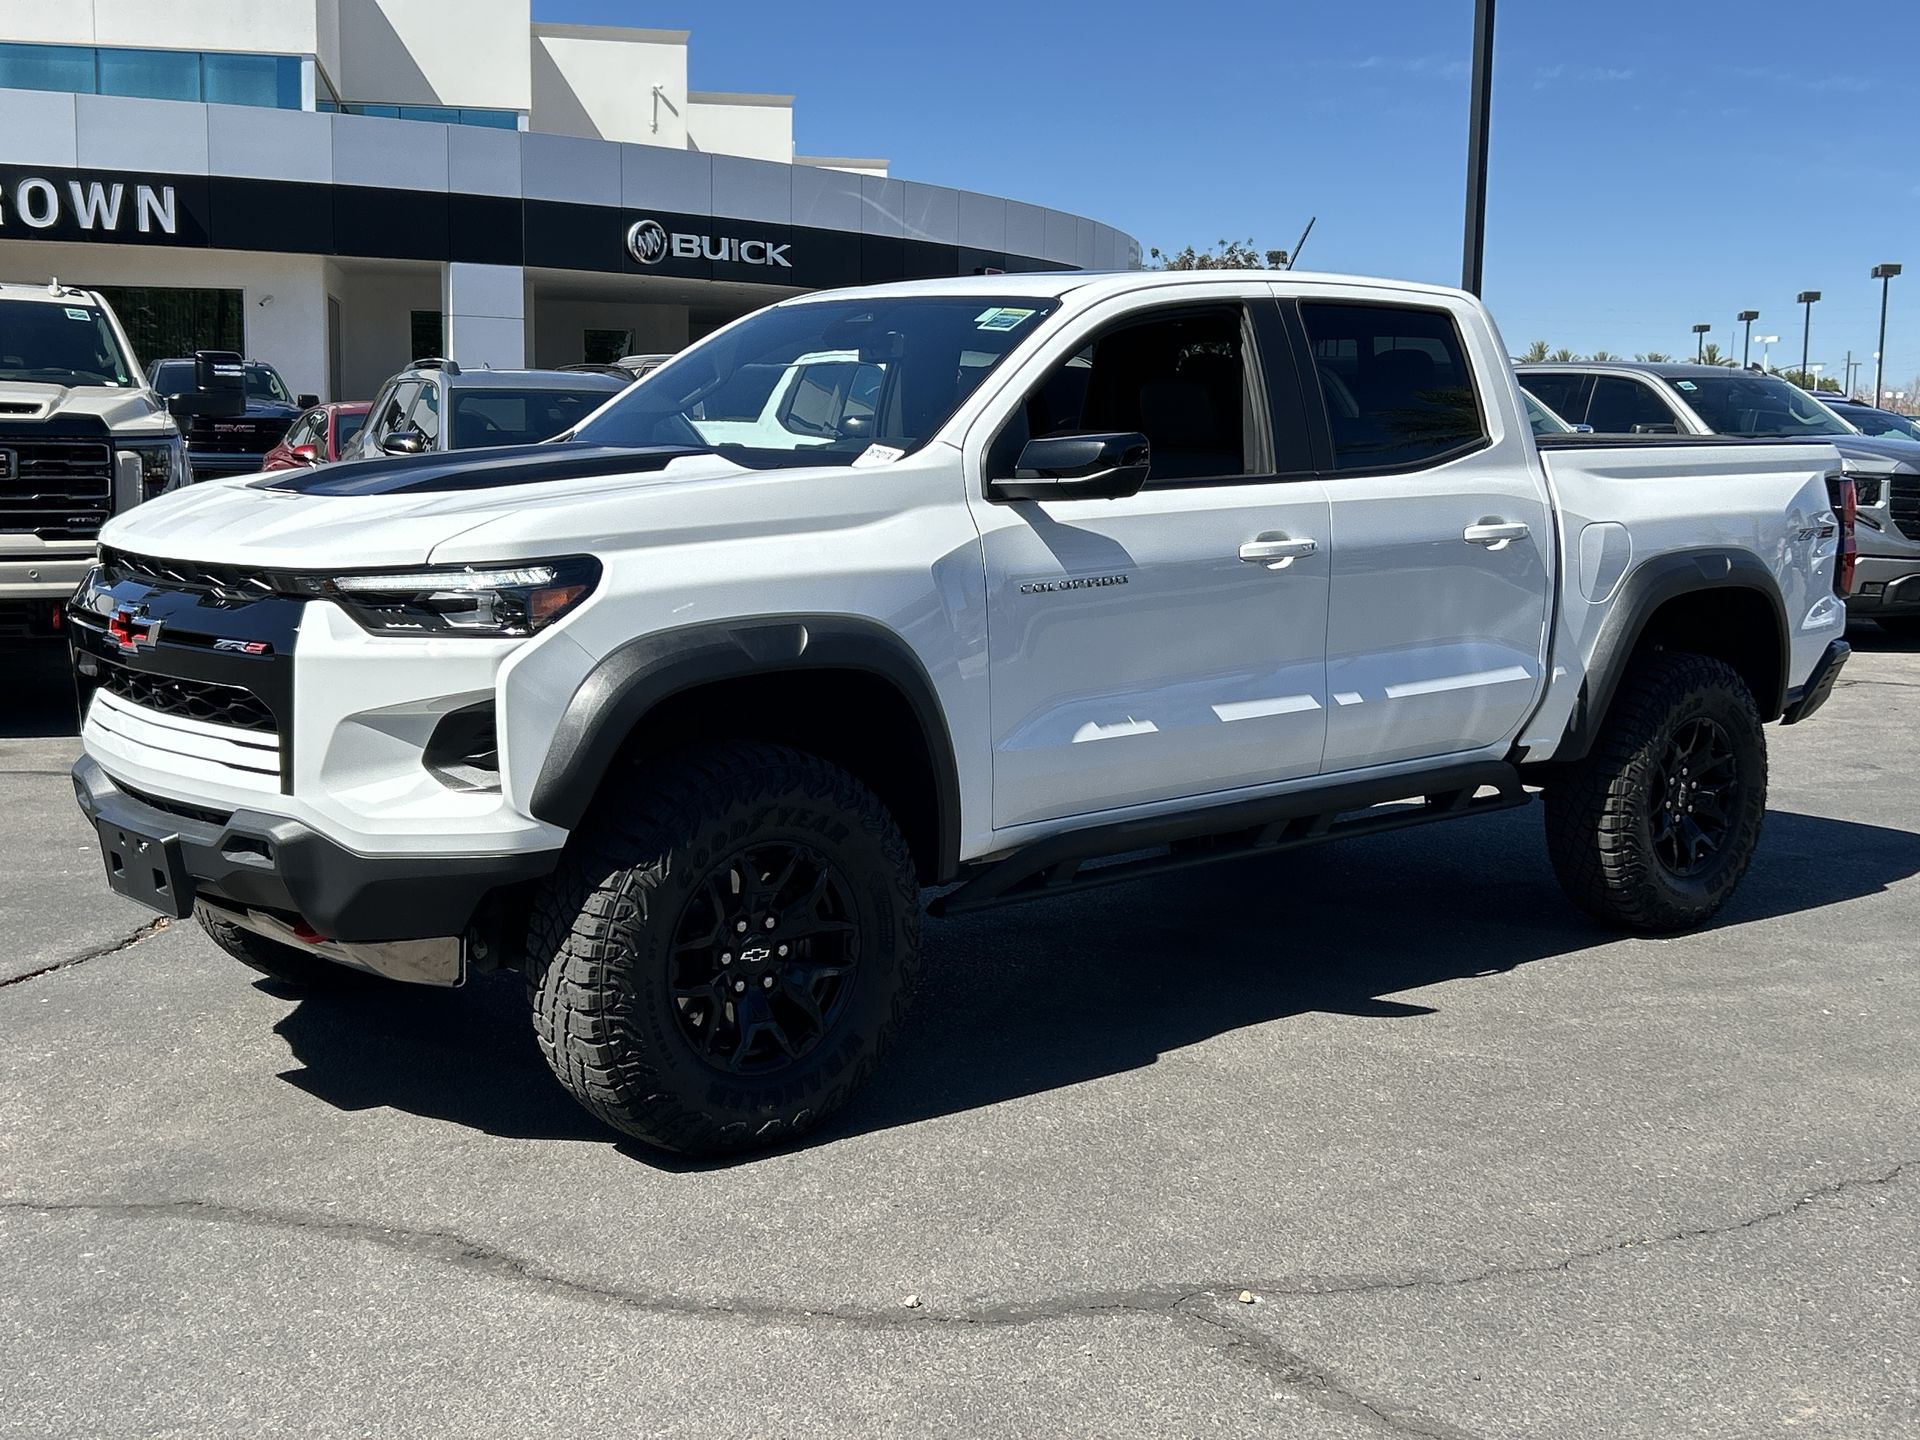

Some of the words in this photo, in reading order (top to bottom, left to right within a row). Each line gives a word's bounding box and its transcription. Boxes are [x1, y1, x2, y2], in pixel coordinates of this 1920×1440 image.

[0, 177, 176, 234] OWN
[670, 233, 793, 267] BUICK
[1020, 574, 1129, 594] COLORADO
[213, 638, 268, 655] ZR2
